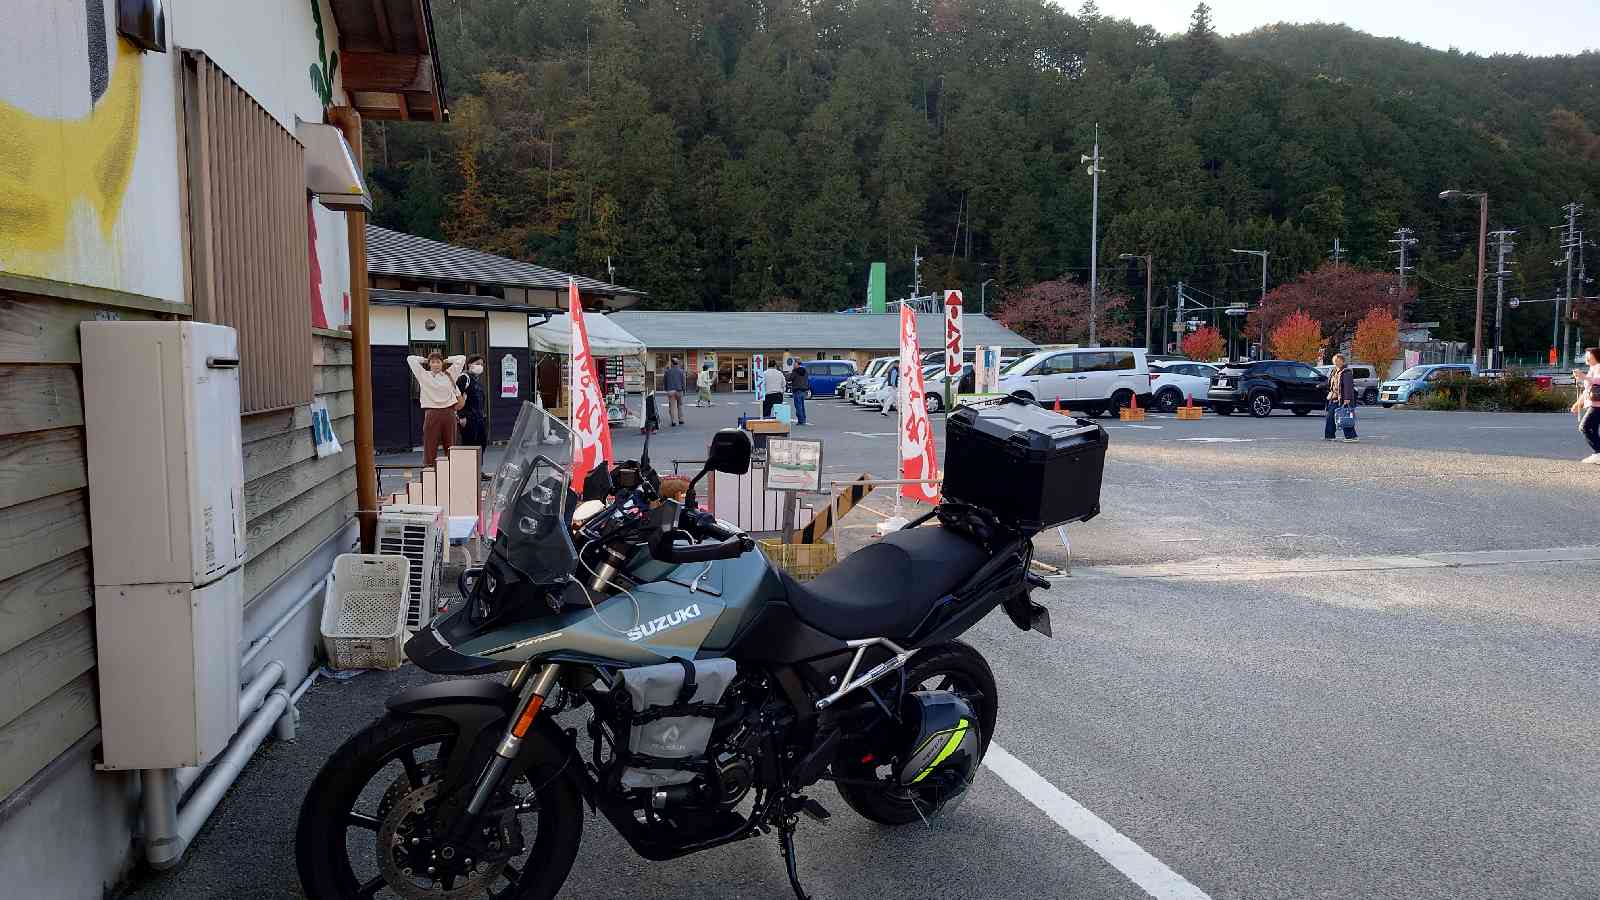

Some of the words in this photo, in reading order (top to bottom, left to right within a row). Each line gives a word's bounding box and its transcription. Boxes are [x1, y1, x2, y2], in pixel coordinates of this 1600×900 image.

[946, 318, 962, 376] トイレ
[627, 603, 701, 642] SUZUKI
